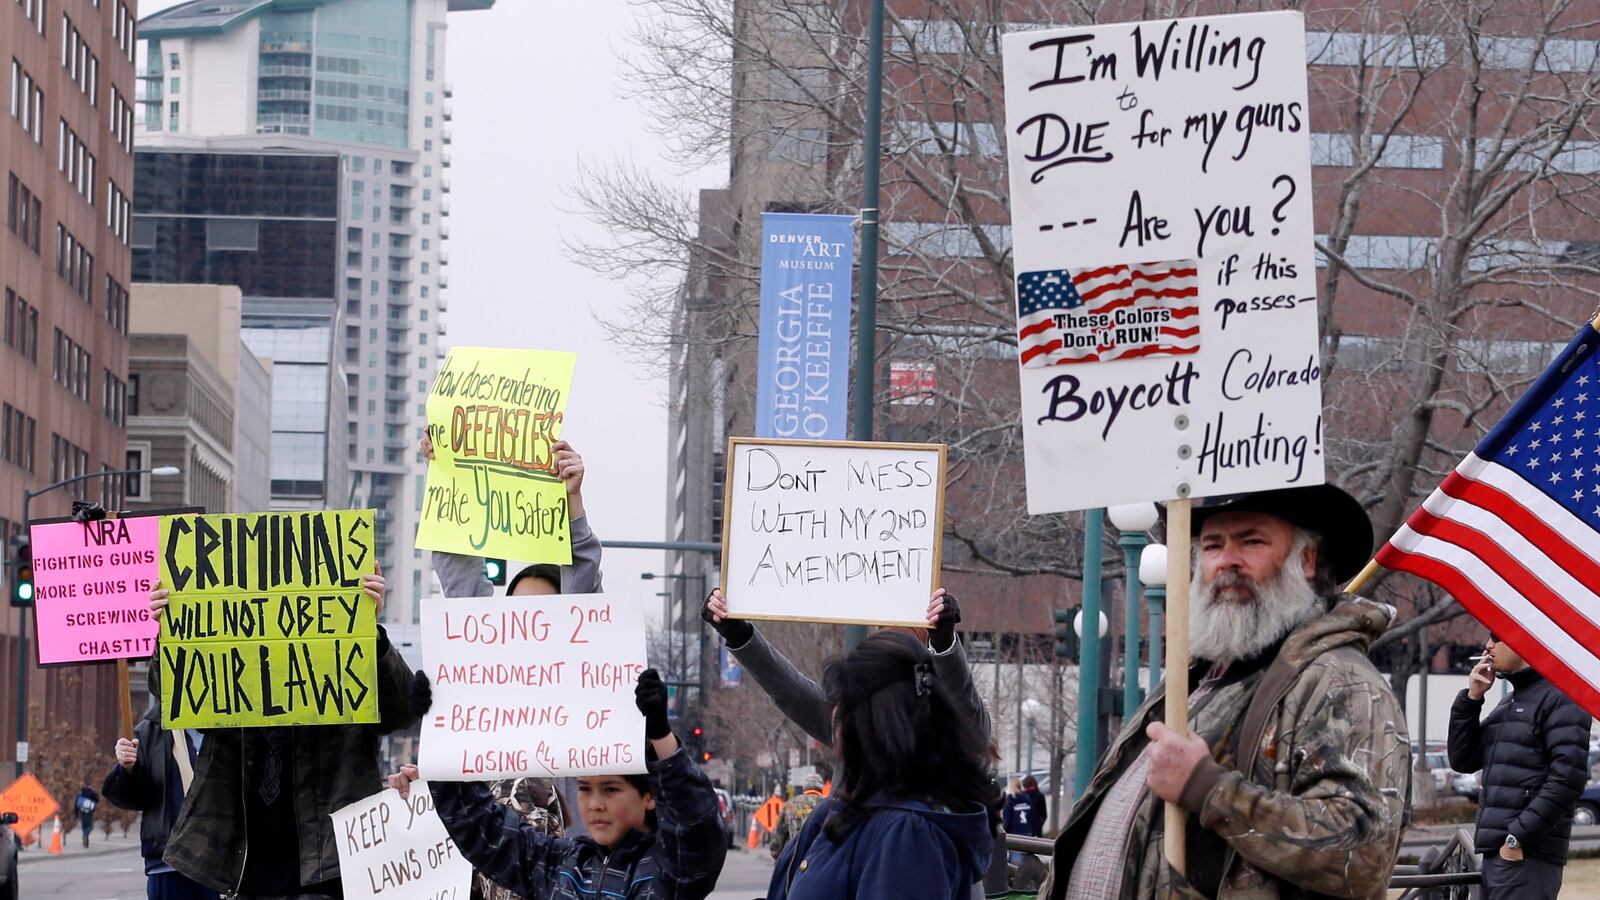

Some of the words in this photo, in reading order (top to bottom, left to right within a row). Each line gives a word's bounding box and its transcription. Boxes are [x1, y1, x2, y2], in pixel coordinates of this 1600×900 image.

[1028, 34, 1117, 91] I'm
[1130, 20, 1266, 91] Willing
[1116, 84, 1138, 111] to
[1016, 113, 1111, 162] DIE
[1131, 109, 1172, 149] for
[1183, 110, 1228, 174] my
[1232, 101, 1302, 161] guns
[770, 234, 822, 244] DENVER
[1119, 190, 1171, 248] Are
[779, 260, 834, 271] MUSEUM
[802, 242, 845, 258] ART
[1217, 253, 1239, 286] if
[1253, 252, 1298, 281] this
[1053, 313, 1109, 329] These
[1115, 308, 1170, 325] Colors
[1063, 331, 1109, 348] Don't
[1116, 326, 1159, 345] RUN!
[773, 282, 804, 437] GEORGIA
[802, 282, 833, 437] O'KEEFFE
[431, 355, 463, 397] How
[461, 361, 500, 401] does
[494, 367, 561, 412] rendering
[1037, 361, 1200, 441] Boycott
[1221, 348, 1321, 401] Colorado
[427, 420, 448, 448] me
[451, 405, 563, 474] DEFENSELESS
[1197, 411, 1322, 483] Hunting!
[847, 458, 932, 492] MESS
[425, 476, 471, 525] make
[84, 519, 131, 547] NRA
[751, 501, 827, 539] WITH
[840, 506, 876, 541] MY
[879, 508, 927, 542] 2ND
[34, 554, 103, 571] FIGHTING
[110, 550, 155, 566] GUNS
[164, 512, 370, 592] CRIMINALS
[749, 543, 928, 587] AMENDMENT
[36, 584, 77, 600] MORE
[83, 580, 127, 596] GUNS
[135, 579, 151, 593] IS
[66, 609, 149, 627] SCREWING
[166, 600, 218, 640] WILL
[223, 597, 269, 637] NOT
[277, 593, 361, 638] OBEY
[445, 609, 551, 645] LOSING
[569, 604, 611, 644] 2nd
[79, 637, 157, 655] CHASTIT
[163, 645, 253, 722] YOUR
[259, 640, 369, 717] LAWS
[436, 661, 566, 688] AMENDMENT
[581, 662, 644, 692] RIGHTS
[586, 709, 611, 730] OF
[462, 750, 528, 775] LOSING
[536, 740, 560, 773] ALL
[568, 743, 633, 769] RIGHTS
[345, 802, 390, 856] KEEP
[368, 848, 422, 894] LAWS
[427, 837, 454, 870] OFF
